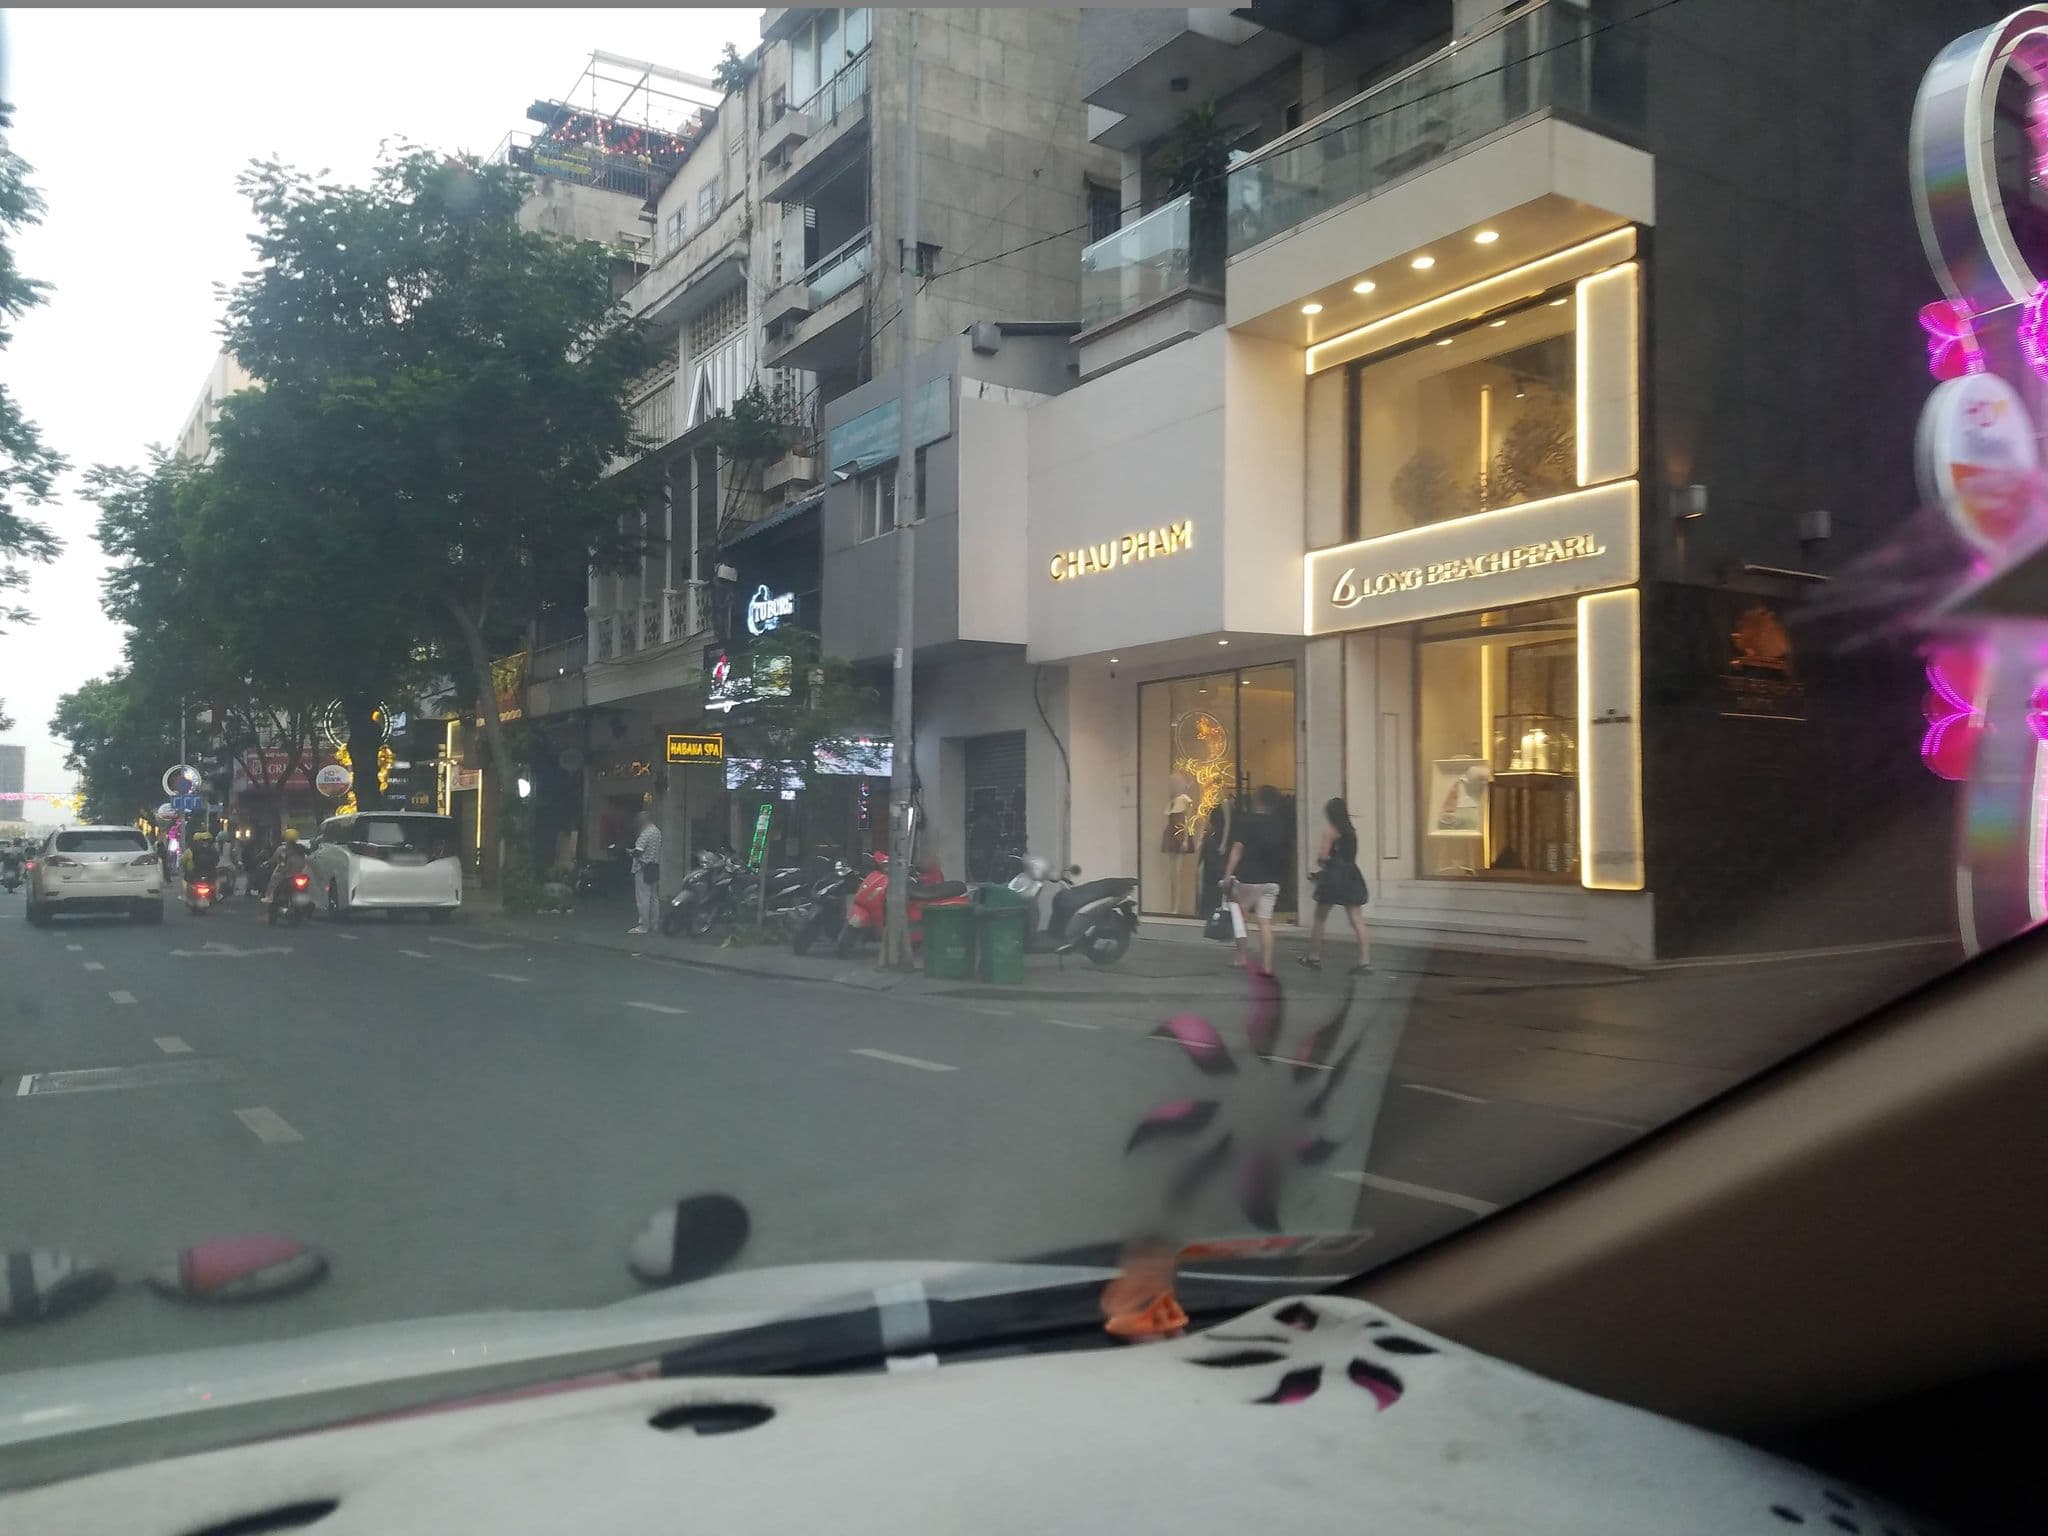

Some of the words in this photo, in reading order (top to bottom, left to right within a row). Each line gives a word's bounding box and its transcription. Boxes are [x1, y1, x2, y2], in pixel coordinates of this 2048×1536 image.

[1050, 541, 1118, 581] CHAU
[1120, 519, 1193, 566] PHAM
[1361, 567, 1423, 598] LONG
[703, 743, 720, 757] SPA
